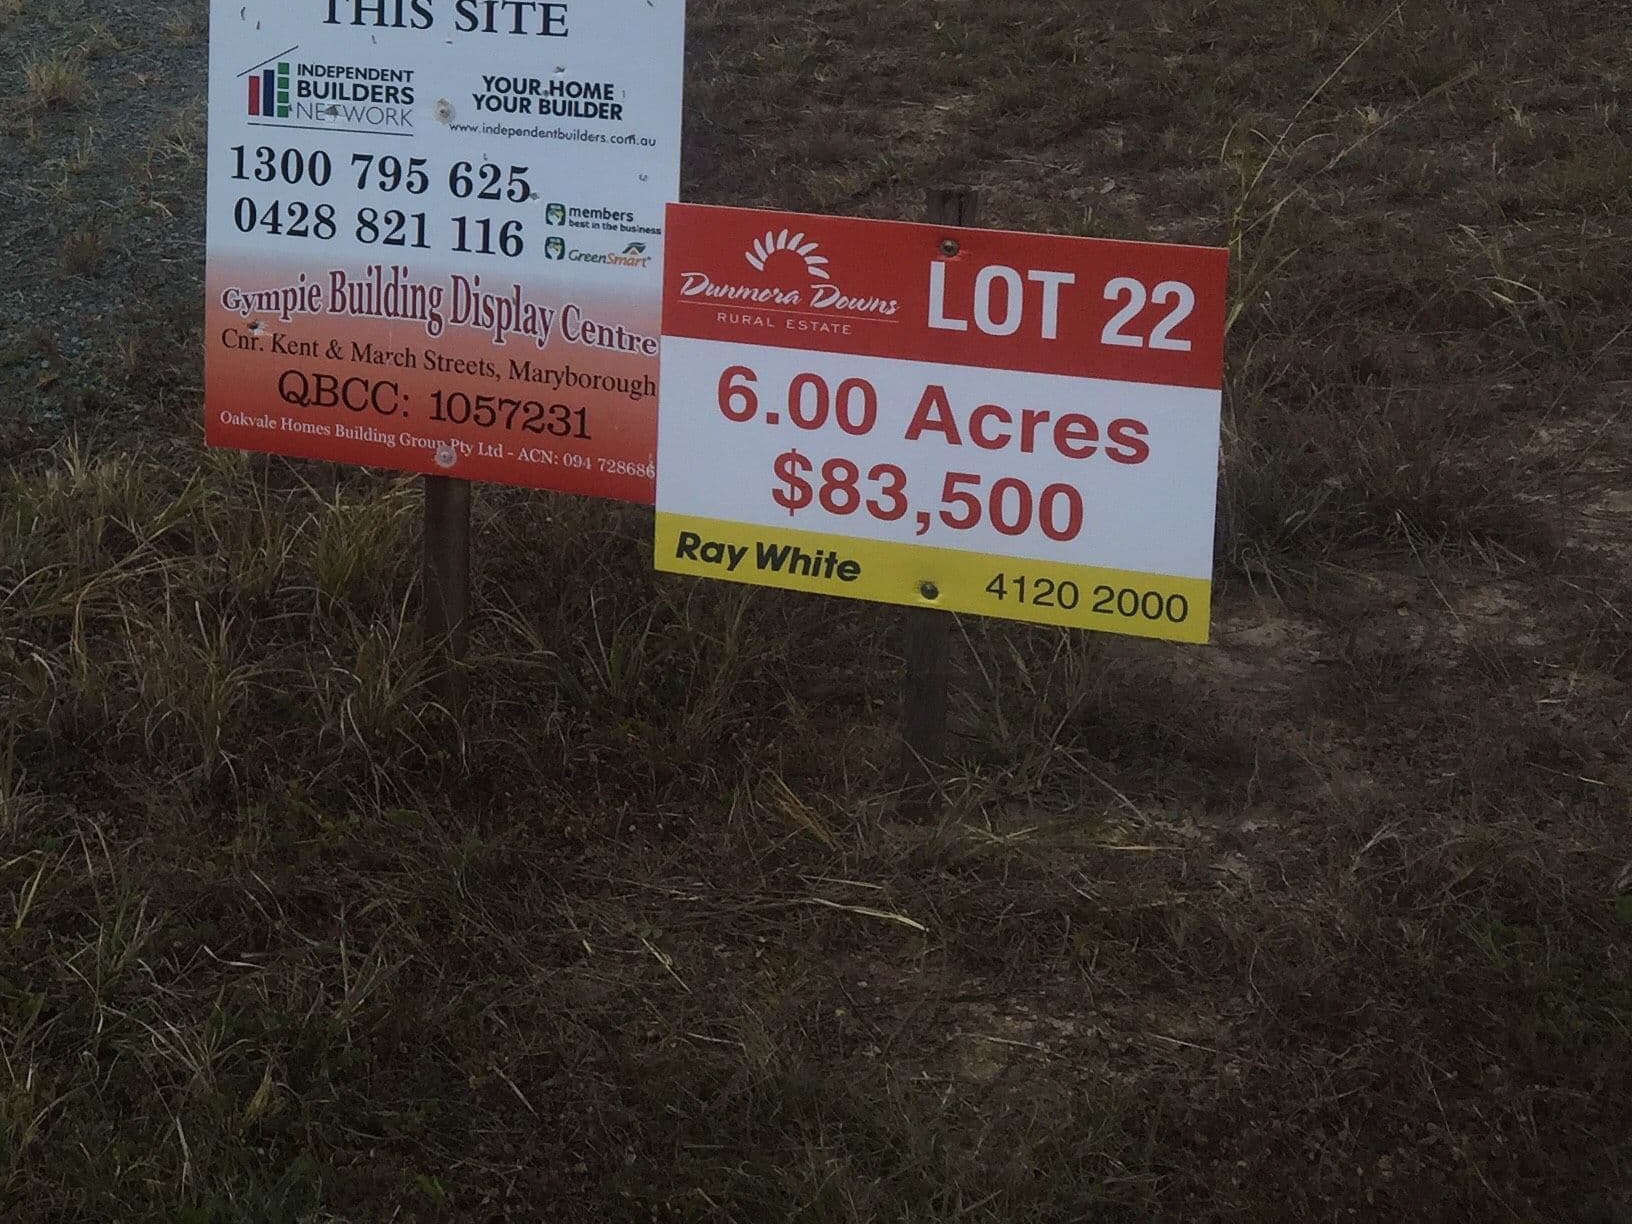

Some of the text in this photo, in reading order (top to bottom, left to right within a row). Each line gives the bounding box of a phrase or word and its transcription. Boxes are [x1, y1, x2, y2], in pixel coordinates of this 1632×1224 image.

[454, 0, 569, 37] SITE
[297, 63, 414, 83] INDEPENDENT
[297, 80, 414, 105] BUILDERS
[482, 75, 614, 101] YOUR HOME
[472, 93, 623, 121] YOUR BUILDER
[449, 122, 657, 147] www.independentbuilders.com.au
[230, 144, 531, 203] 1300 795 625
[233, 196, 525, 257] 0428 821 116
[569, 206, 634, 222] members
[569, 219, 661, 235] best in the business
[220, 265, 658, 356] Gympie Building Display Centre
[680, 272, 900, 315] Dunmora Downs
[927, 260, 1196, 353] LOT 22
[717, 312, 852, 335] RURAL ESTATE
[221, 328, 656, 401] Cnr. Kent & March Streets, Maryborough
[278, 370, 592, 440] QBCC: 1057231
[716, 364, 1151, 466] 6.00 Acres
[220, 410, 277, 429] Oakvale
[280, 417, 331, 436] Homes
[335, 424, 396, 446] Building
[451, 438, 473, 457] Pty
[478, 442, 504, 458] Ltd
[518, 448, 558, 465] ACN:
[563, 453, 592, 470] 094
[771, 449, 1085, 542] $83,500
[675, 530, 861, 582] Ray White
[986, 572, 1189, 624] 4120 2000
